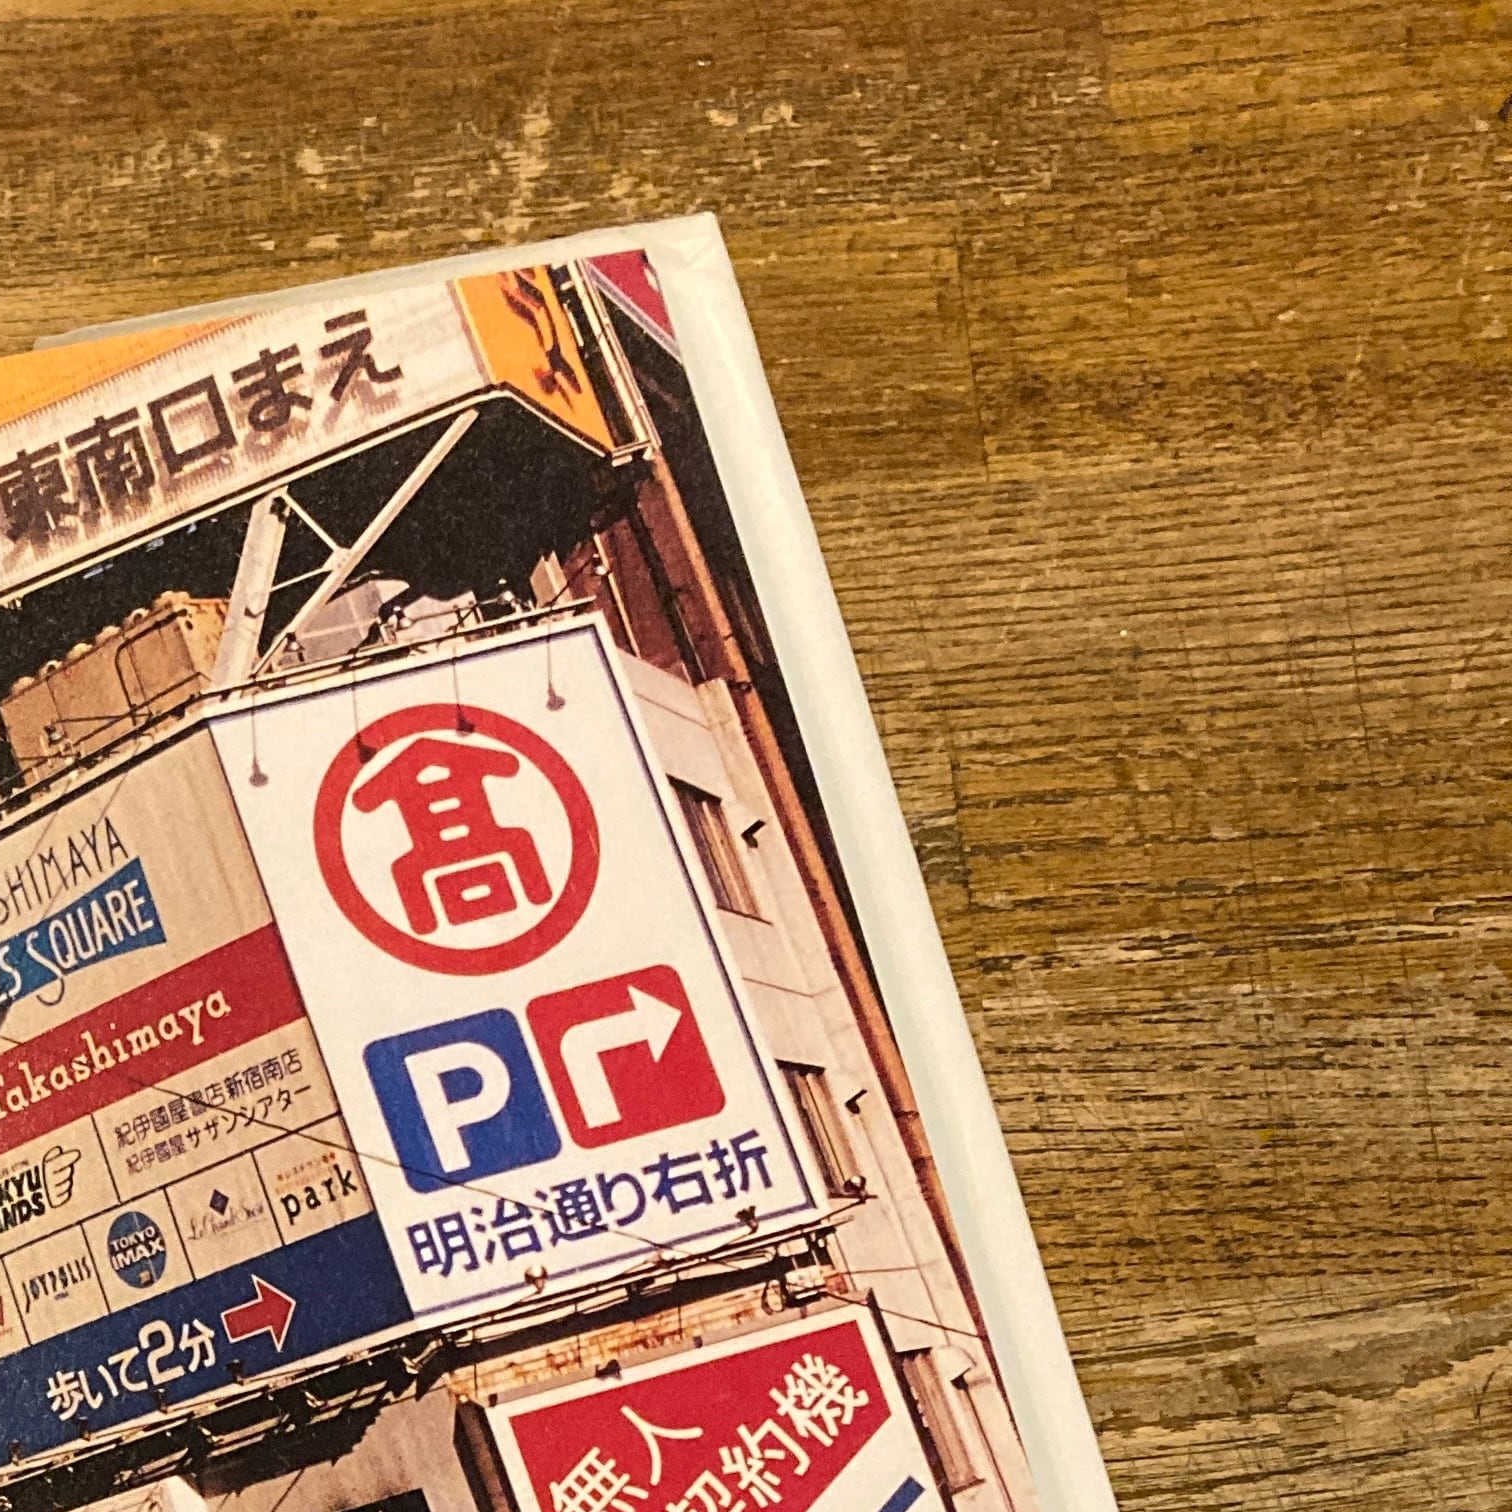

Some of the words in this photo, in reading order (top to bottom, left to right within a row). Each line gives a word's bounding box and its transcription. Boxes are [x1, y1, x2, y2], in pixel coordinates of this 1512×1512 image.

[28, 879, 154, 1008] SQUARE
[406, 1041, 512, 1172] P
[109, 1224, 157, 1252] TOKYO
[278, 1163, 359, 1226] park
[406, 1128, 773, 1279] 明治通り右折
[111, 1236, 166, 1271] IMAX
[47, 1318, 217, 1421] 歩いて2分
